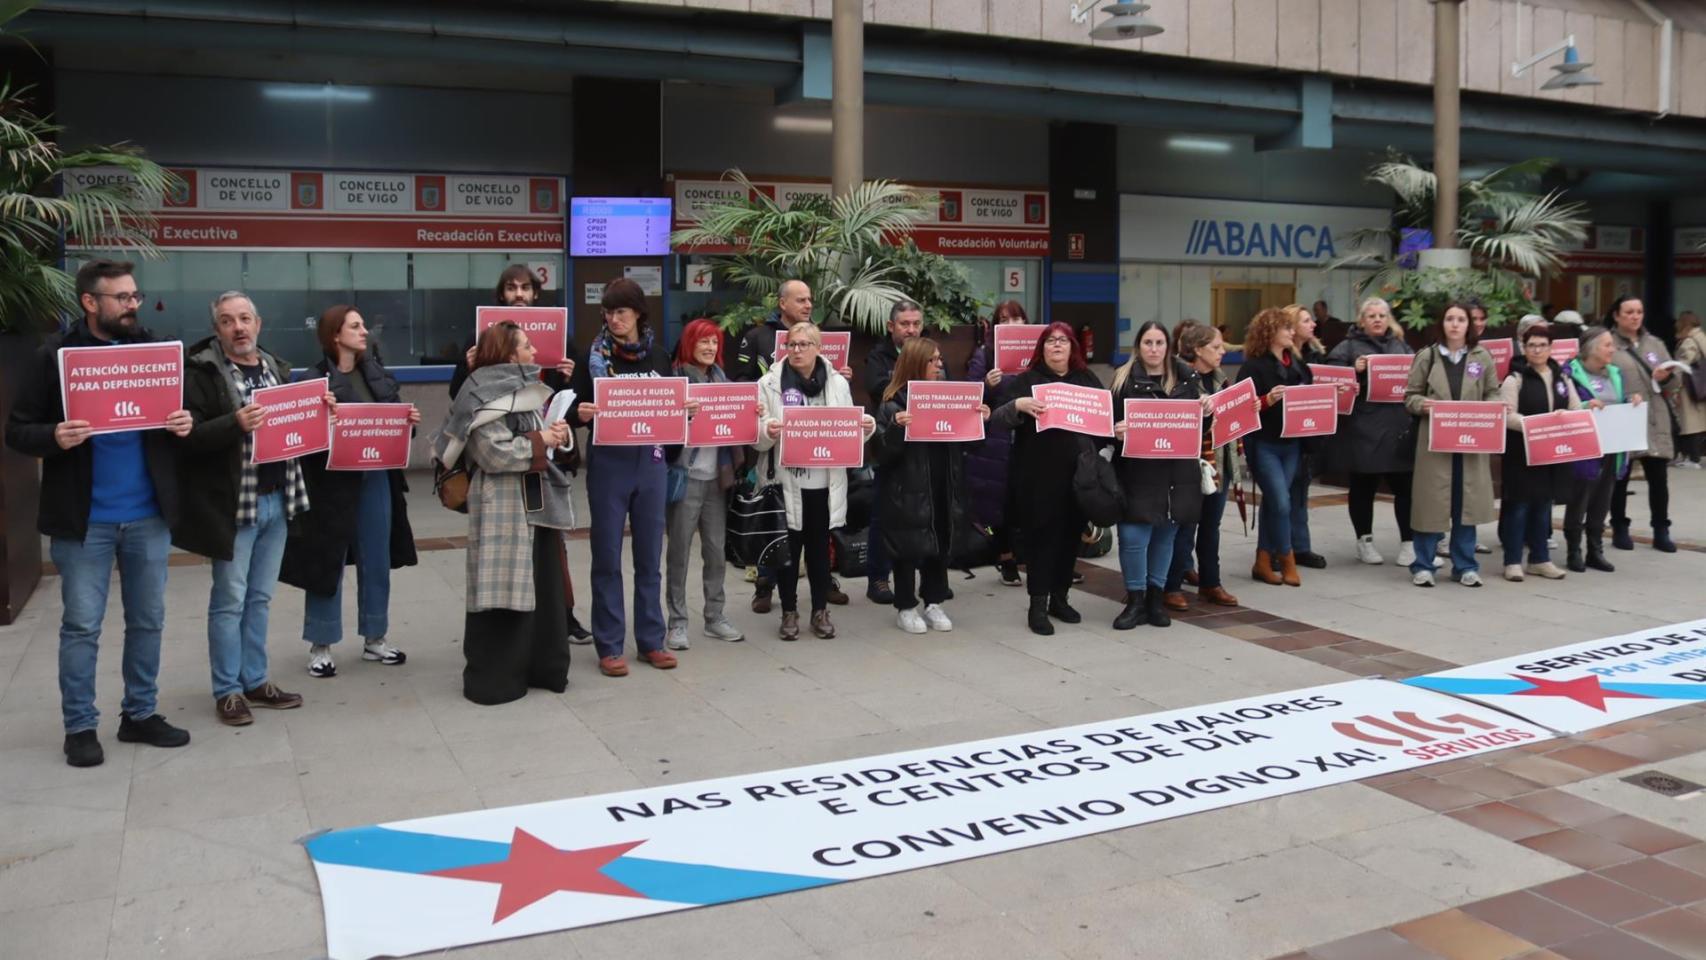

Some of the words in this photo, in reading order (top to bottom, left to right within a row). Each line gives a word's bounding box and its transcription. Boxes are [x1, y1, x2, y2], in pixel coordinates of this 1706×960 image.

[211, 178, 281, 189] CONCELLO
[339, 180, 406, 192] CONCELLO
[458, 183, 521, 194] CONCELLO
[219, 190, 236, 200] DE
[241, 190, 273, 201] VIGO
[347, 193, 364, 203] DE
[368, 193, 398, 203] VIGO
[465, 195, 481, 205] DE
[483, 196, 514, 206] VIGO
[970, 198, 1018, 208] CONCELLO
[976, 208, 989, 217] DE
[992, 208, 1012, 217] VIGO
[163, 226, 238, 240] Executiva
[417, 229, 493, 242] Recadación
[498, 230, 562, 242] Executiva
[938, 236, 996, 249] Recadación
[999, 238, 1048, 249] Voluntaria
[536, 266, 548, 285] 3
[693, 272, 705, 287] 4
[1010, 272, 1019, 287] 5
[524, 322, 557, 331] LOITA!
[70, 363, 128, 377] ATENCIÓN
[131, 362, 177, 374] DECENTE
[69, 382, 100, 391] PARA
[103, 376, 179, 390] DEPENDENTES!
[608, 388, 642, 396] FABIOLA
[649, 388, 675, 396] RUEDA
[607, 398, 663, 407] RESPONSÁBEIS
[267, 412, 305, 427] CONVENIO
[599, 410, 655, 418] PRECARIEDADE
[1152, 421, 1198, 429] RESPONSÁBEL!
[819, 430, 858, 438] MELLORAR
[1516, 642, 1654, 674] SERVIZO
[1645, 633, 1699, 646] DE
[1586, 660, 1648, 677] Por
[1402, 727, 1537, 762] SERVIZOS
[606, 791, 732, 823] NAS
[743, 738, 1082, 803] RESIDENCIAS
[1084, 727, 1153, 747] DE
[1152, 695, 1344, 737] MAIORES
[818, 797, 858, 816] E
[867, 755, 1111, 808] CENTROS
[1113, 743, 1184, 765] DE
[1183, 728, 1274, 752] DÍA
[811, 799, 1126, 868] CONVENIO
[1128, 764, 1301, 808] DIGNO
[1297, 747, 1389, 774] XA!
